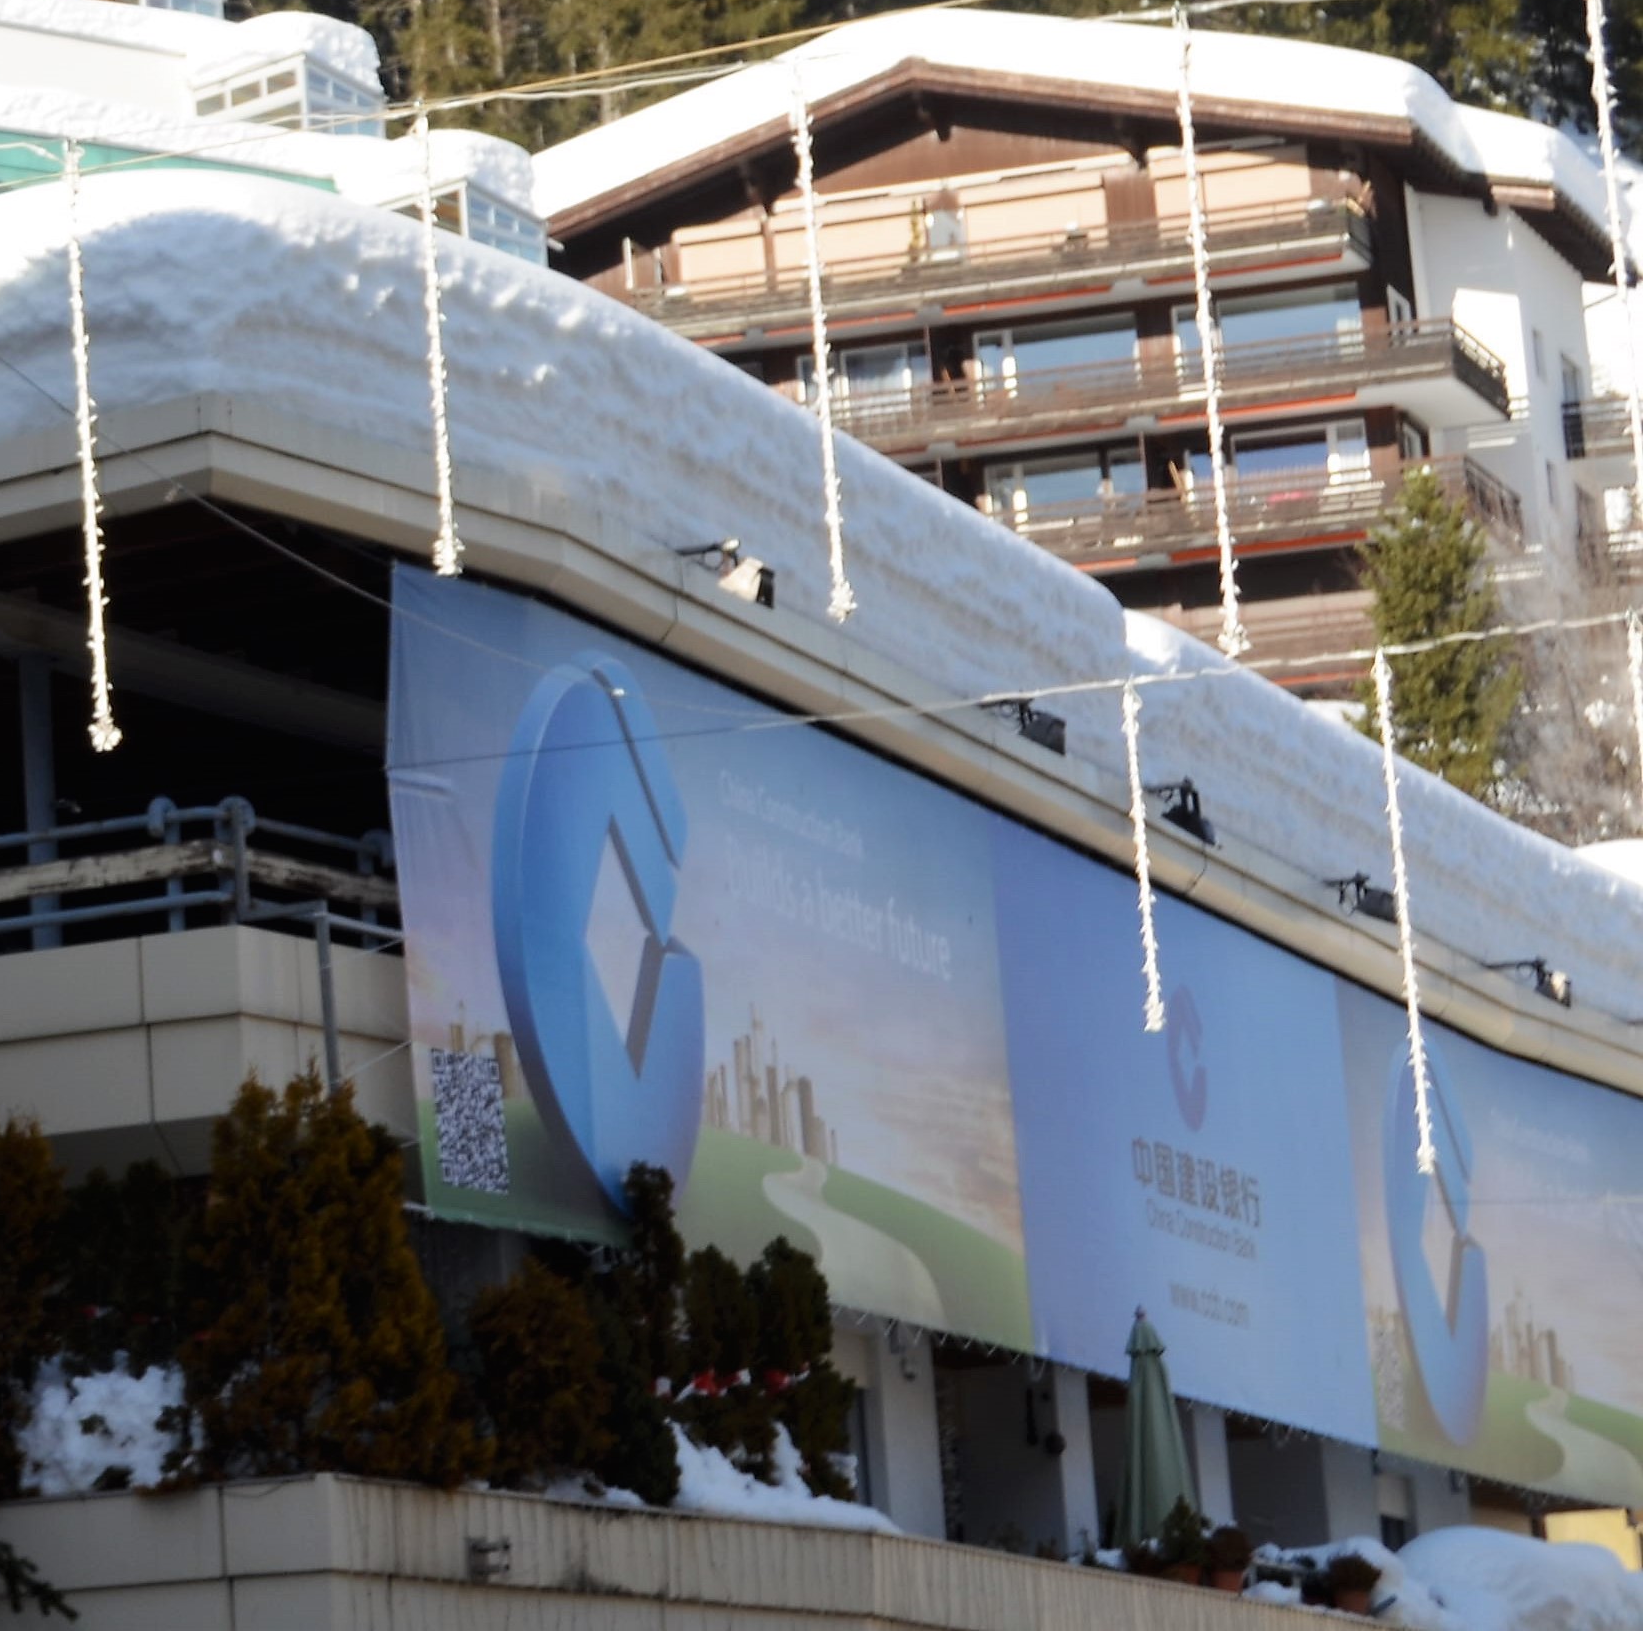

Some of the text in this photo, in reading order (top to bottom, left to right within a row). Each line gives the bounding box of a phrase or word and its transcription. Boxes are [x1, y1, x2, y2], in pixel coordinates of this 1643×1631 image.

[885, 895, 953, 983] future
[1131, 1135, 1261, 1230] 中国建设银行
